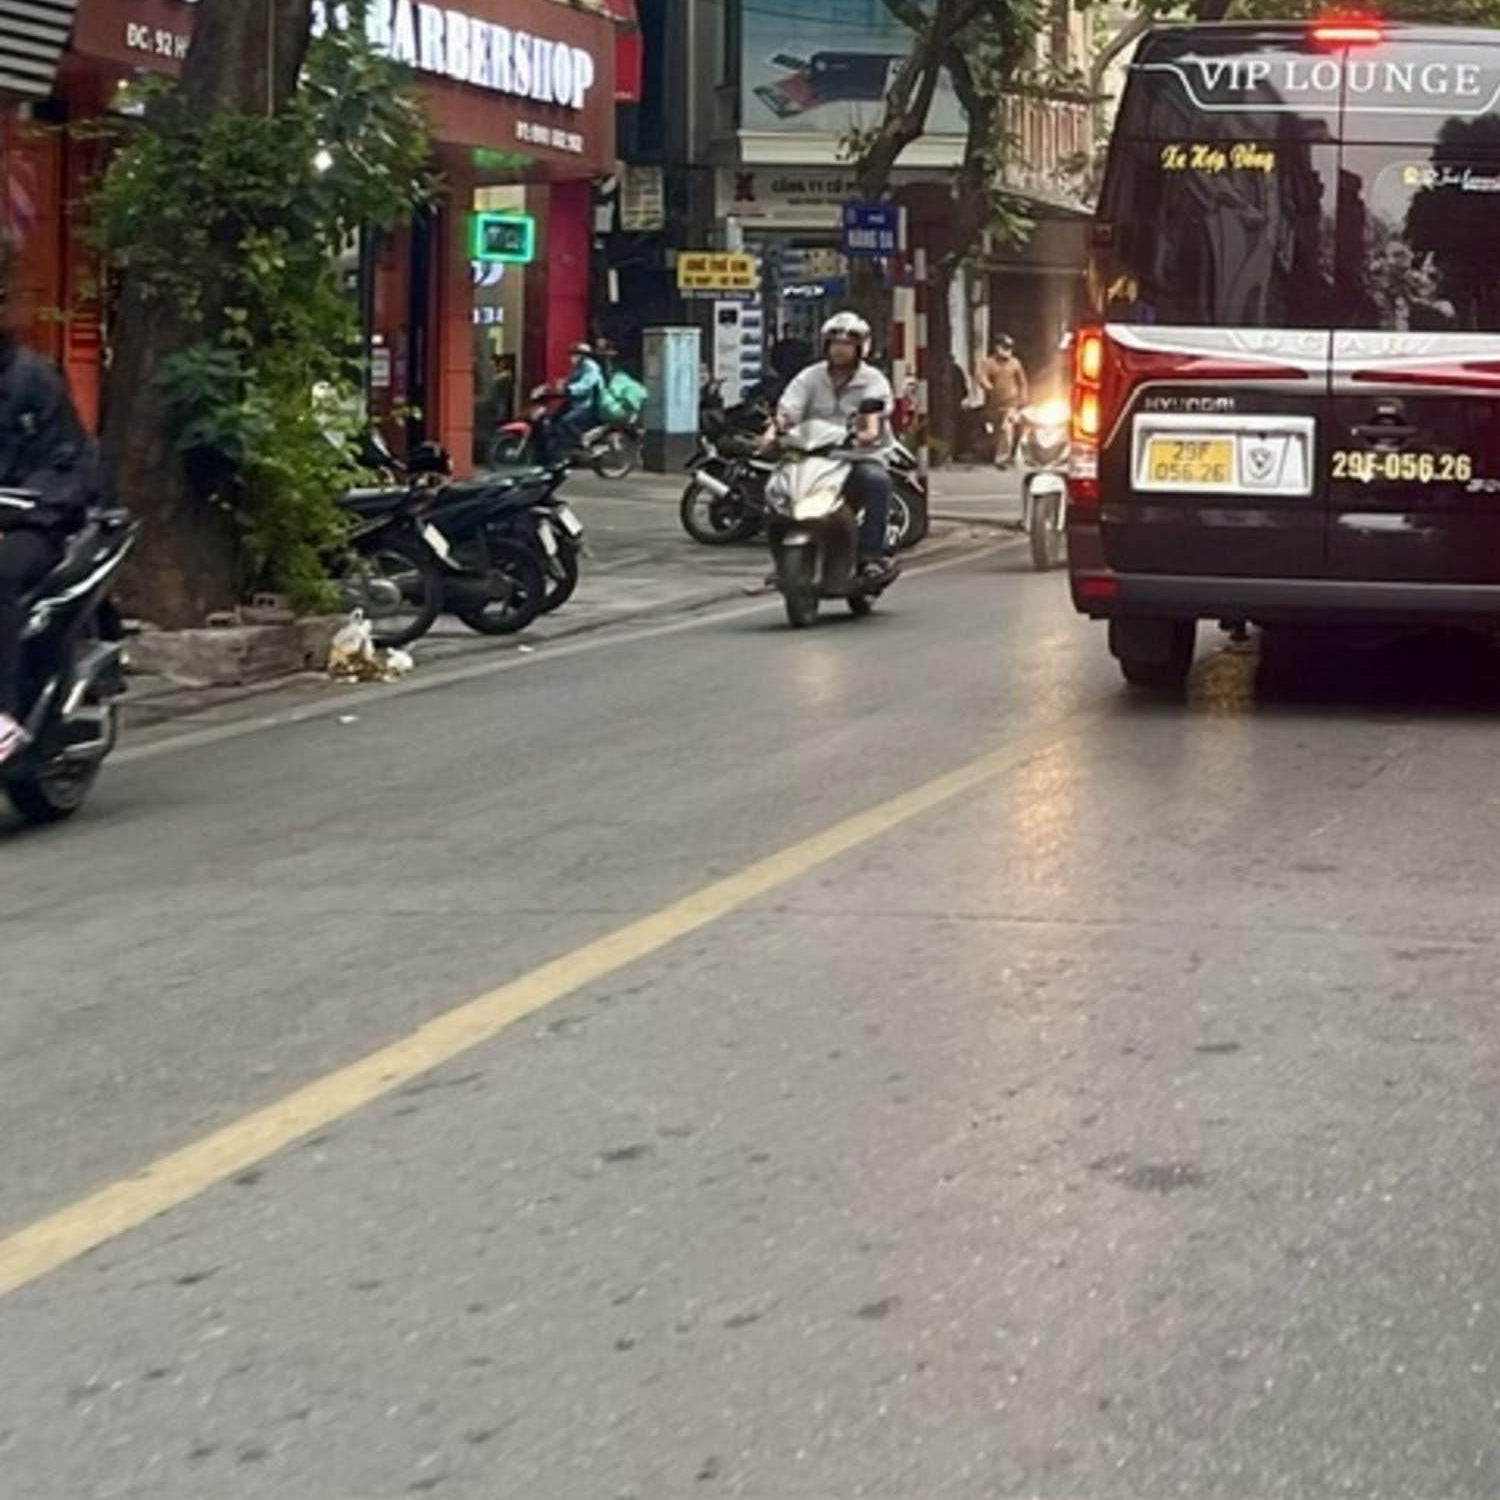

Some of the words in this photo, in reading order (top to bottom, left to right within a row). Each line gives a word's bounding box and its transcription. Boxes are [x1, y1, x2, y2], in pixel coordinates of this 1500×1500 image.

[1199, 58, 1270, 91] VIP
[1285, 61, 1481, 96] LOUNGE
[1144, 396, 1235, 412] HYUNDAI
[1172, 440, 1212, 461] 29F
[1154, 462, 1225, 483] 056.26
[1331, 450, 1472, 481] 29F-056.26
